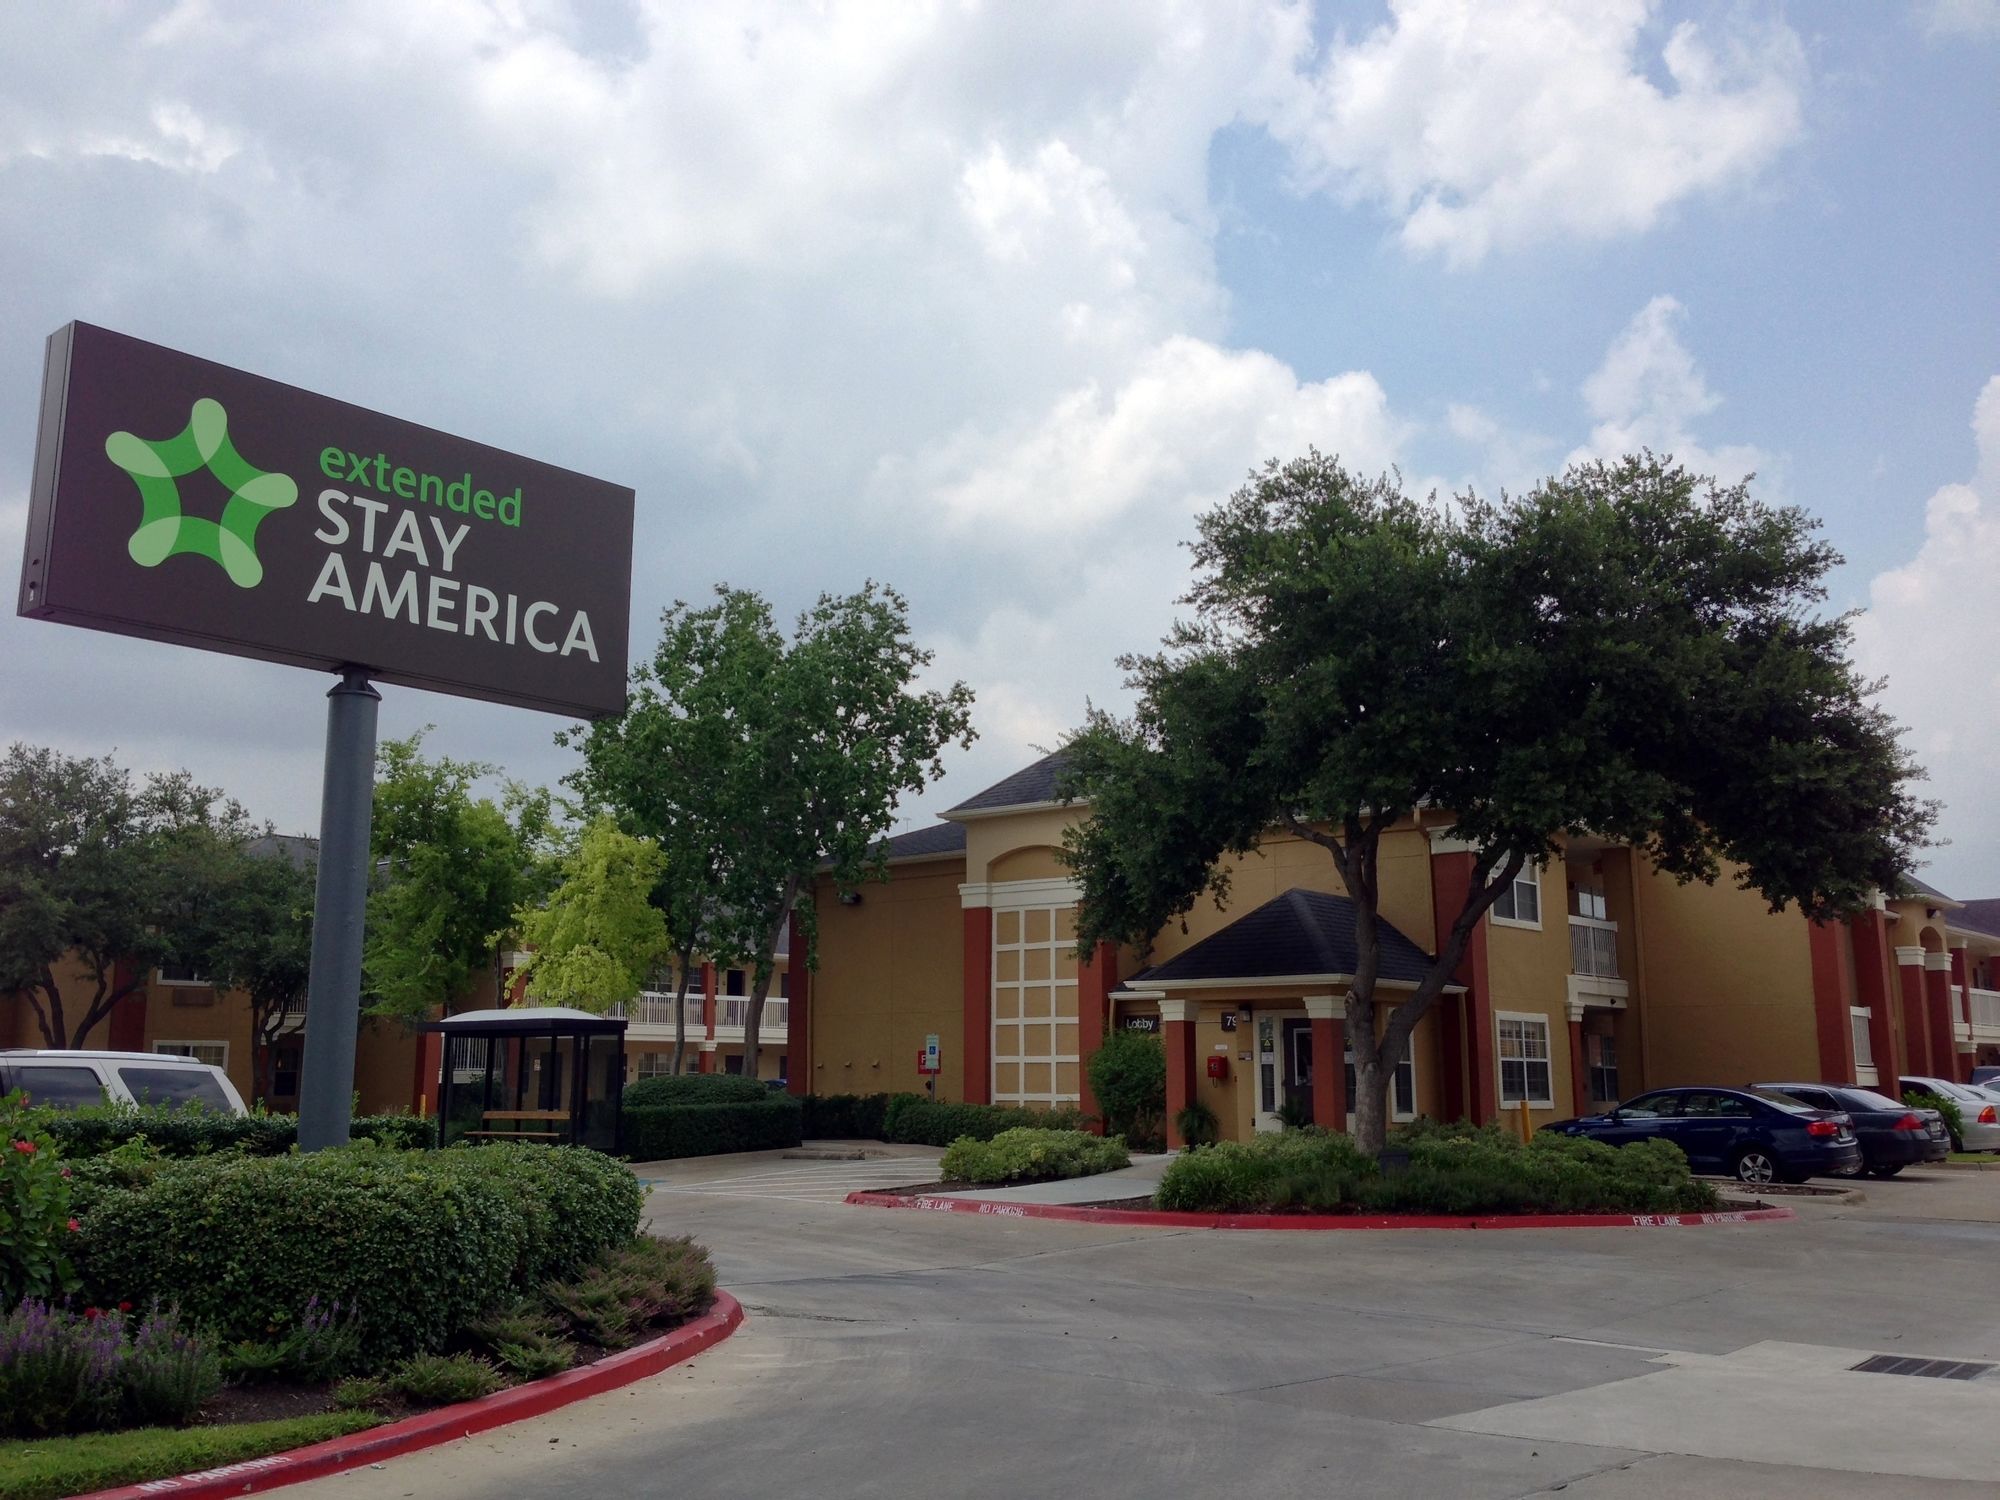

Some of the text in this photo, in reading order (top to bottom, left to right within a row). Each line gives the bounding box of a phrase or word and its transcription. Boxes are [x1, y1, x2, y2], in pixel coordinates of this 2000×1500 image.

[320, 446, 523, 528] extended
[314, 488, 471, 572] STAY
[307, 552, 601, 663] AMERICA
[1126, 1018, 1154, 1031] Lobby
[916, 1199, 954, 1213] FIRE LANE
[978, 1203, 1024, 1217] NO PARKING
[1632, 1215, 1683, 1226] FIRE LANE
[1701, 1211, 1747, 1225] NO PARKING
[135, 1455, 293, 1493] NO PARKING
